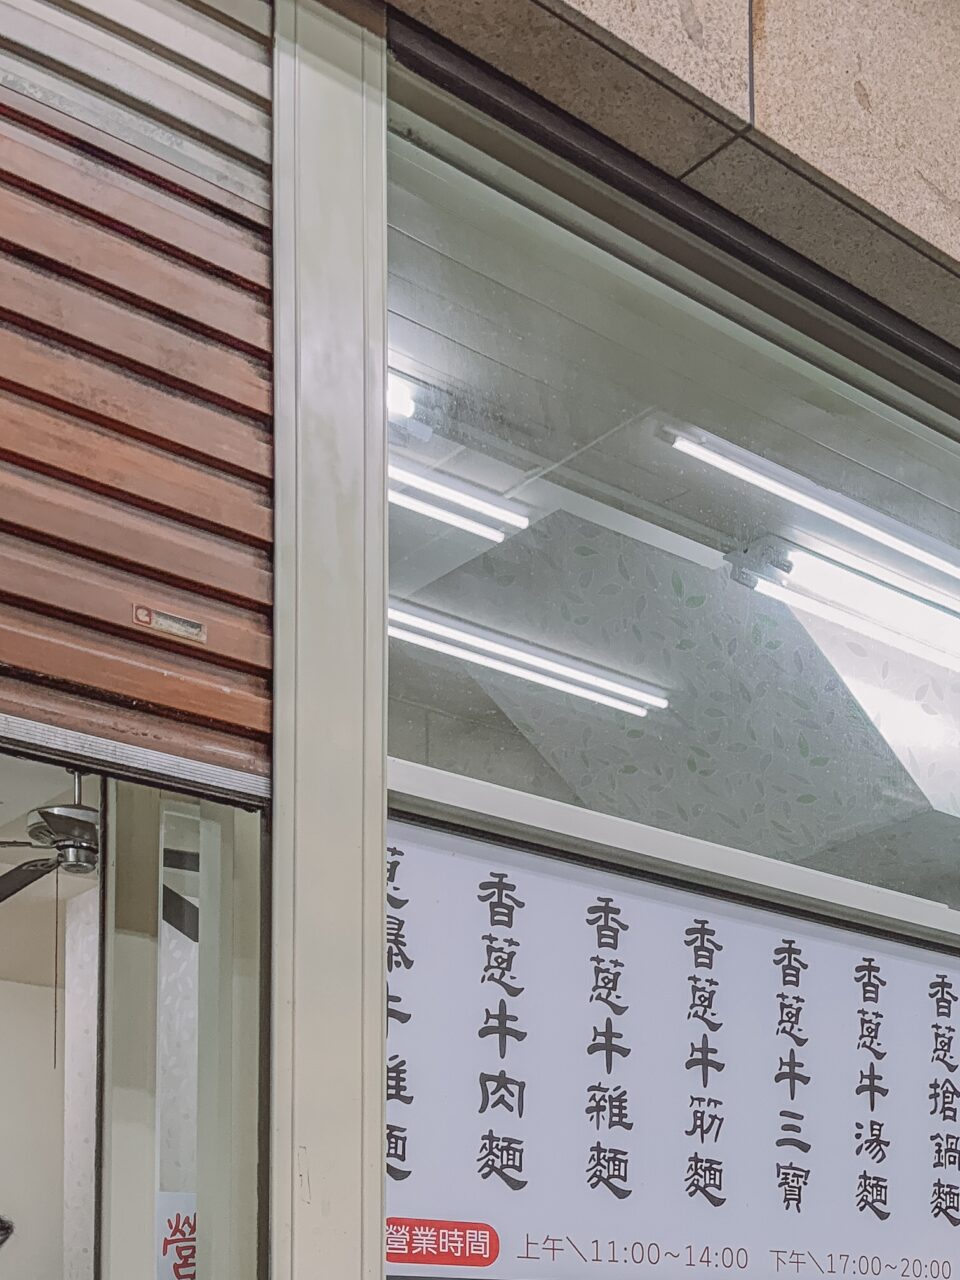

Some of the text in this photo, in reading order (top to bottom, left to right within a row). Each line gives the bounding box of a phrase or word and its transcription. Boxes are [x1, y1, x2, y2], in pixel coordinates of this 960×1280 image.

[477, 871, 529, 1191] 香蔥牛肉麵
[584, 896, 634, 1200] 香蔥牛雜麵
[683, 918, 727, 1208] 香蔥牛筋麵
[773, 938, 812, 1214] 香蔥牛三寶
[854, 956, 891, 1221] 香蔥牛湯麵
[386, 1224, 490, 1258] 營業時間
